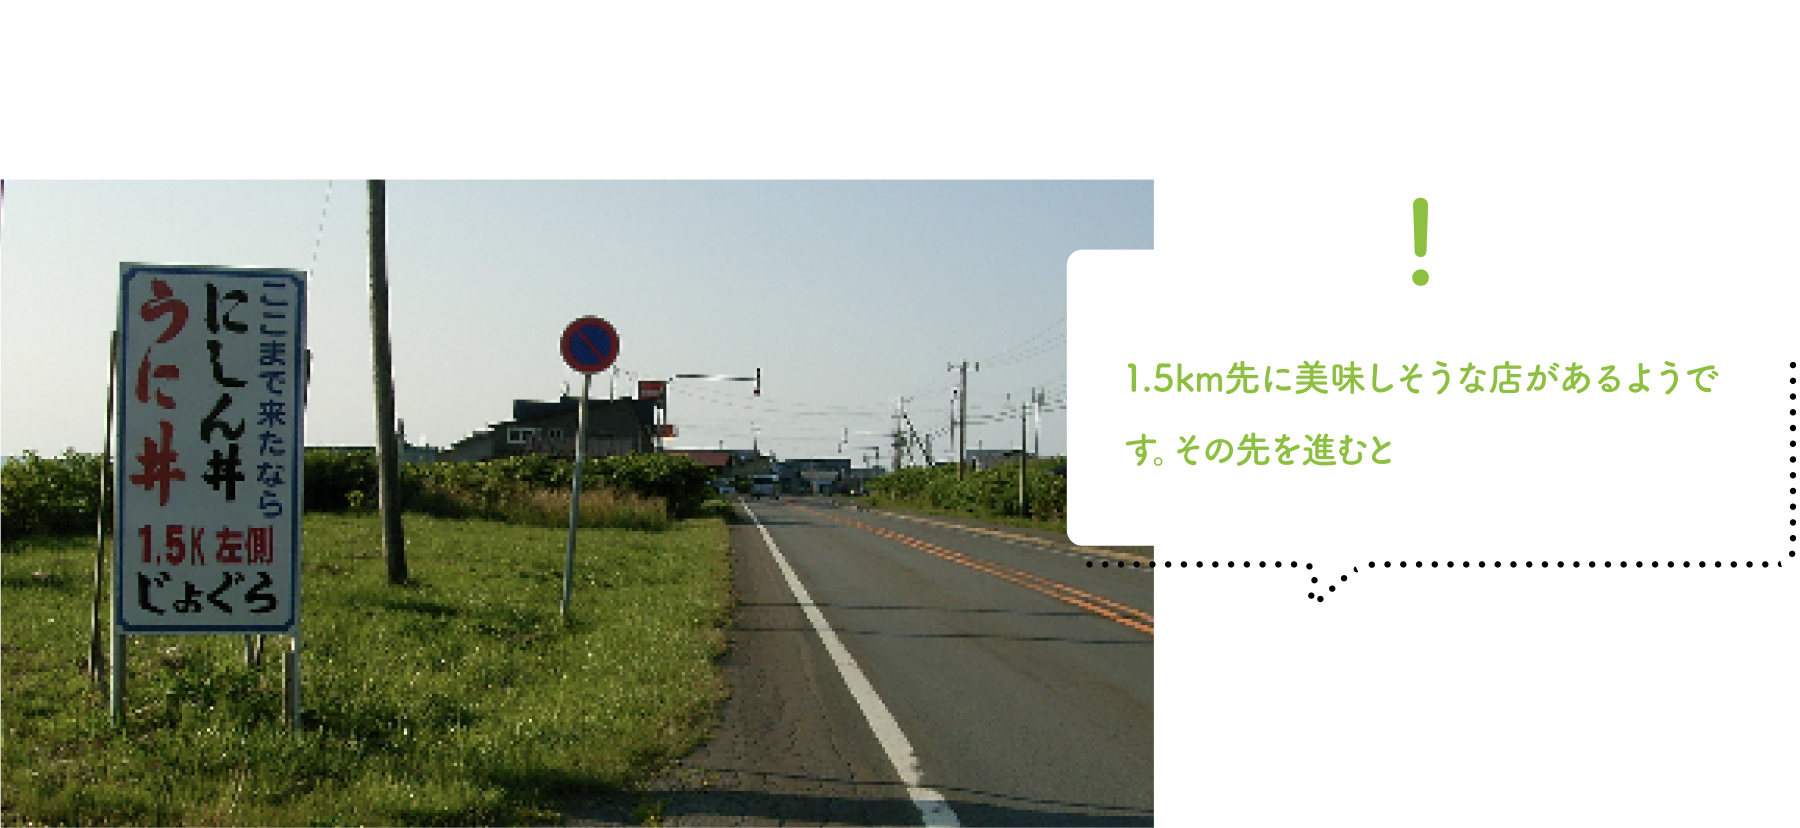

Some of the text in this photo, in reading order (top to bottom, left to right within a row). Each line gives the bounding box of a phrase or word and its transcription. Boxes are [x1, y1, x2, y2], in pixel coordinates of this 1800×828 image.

[256, 280, 288, 519] ここまで来たなら
